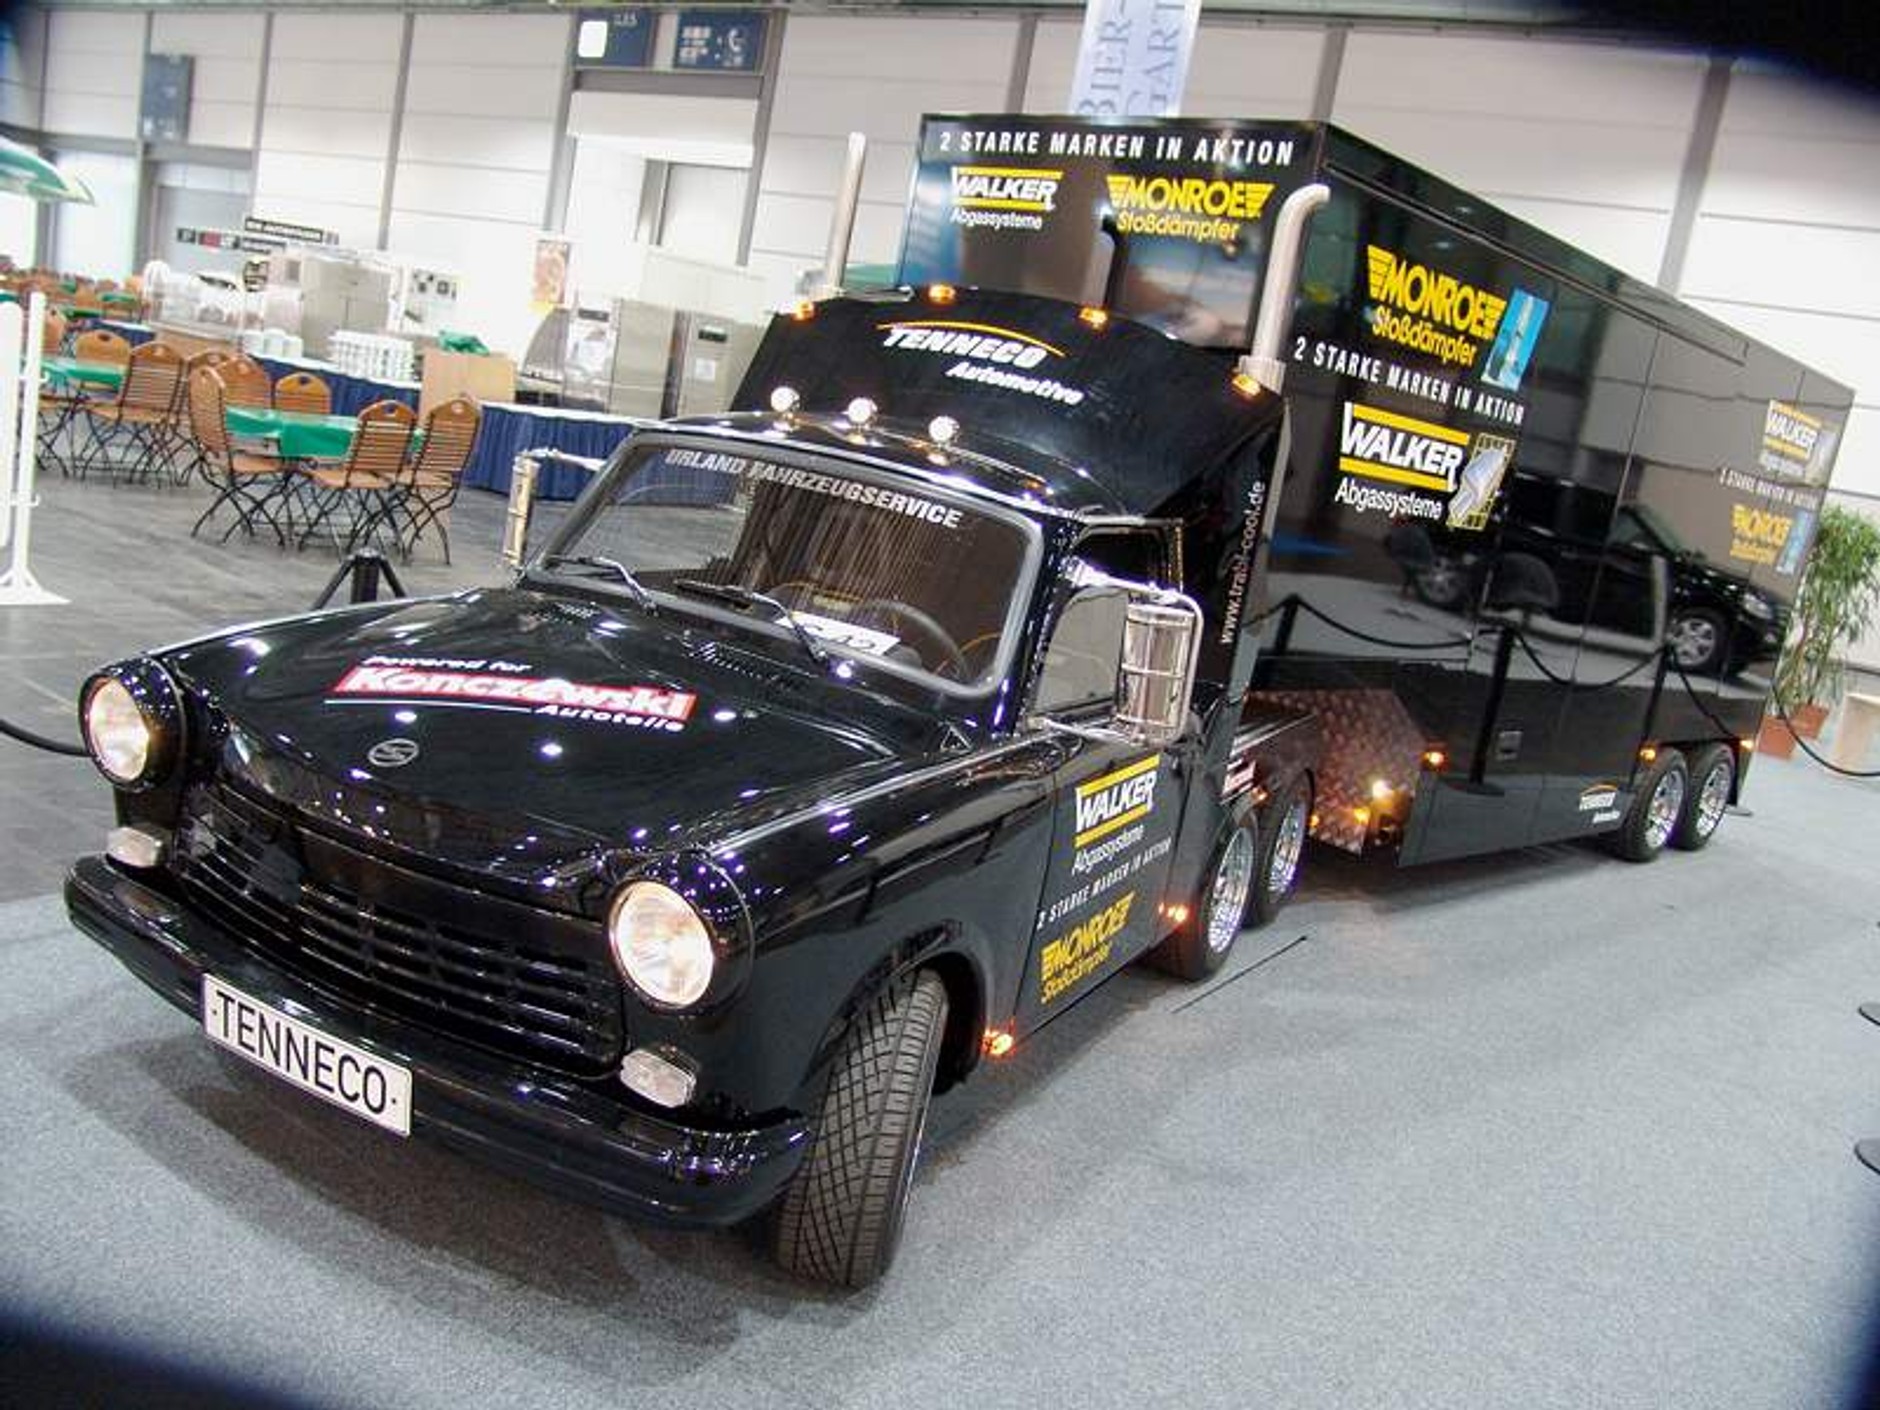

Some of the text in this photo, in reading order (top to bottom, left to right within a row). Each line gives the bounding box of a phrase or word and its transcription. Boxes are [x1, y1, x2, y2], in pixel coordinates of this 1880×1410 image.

[939, 132, 1295, 167] 2 STARKE MARKEN IN AKTION
[951, 167, 1057, 211] WALKER
[1113, 175, 1258, 218] MONROE
[950, 208, 1044, 232] Abgassysteme
[1116, 210, 1241, 244] Stoßdämpfer
[1374, 252, 1496, 339] MONROE
[882, 327, 1049, 369] TENNECO
[1371, 304, 1478, 367] Stoßdämpfer
[944, 362, 1085, 406] Automotive
[1293, 336, 1525, 426] 2 STARKE MARKEN IN AKTION
[1339, 402, 1464, 492] WALKER
[748, 459, 964, 529] FAHRZEUGSERVICE
[1334, 476, 1444, 520] Abgassysteme
[1075, 770, 1158, 834] WALKER
[215, 989, 387, 1115] TENNECO
